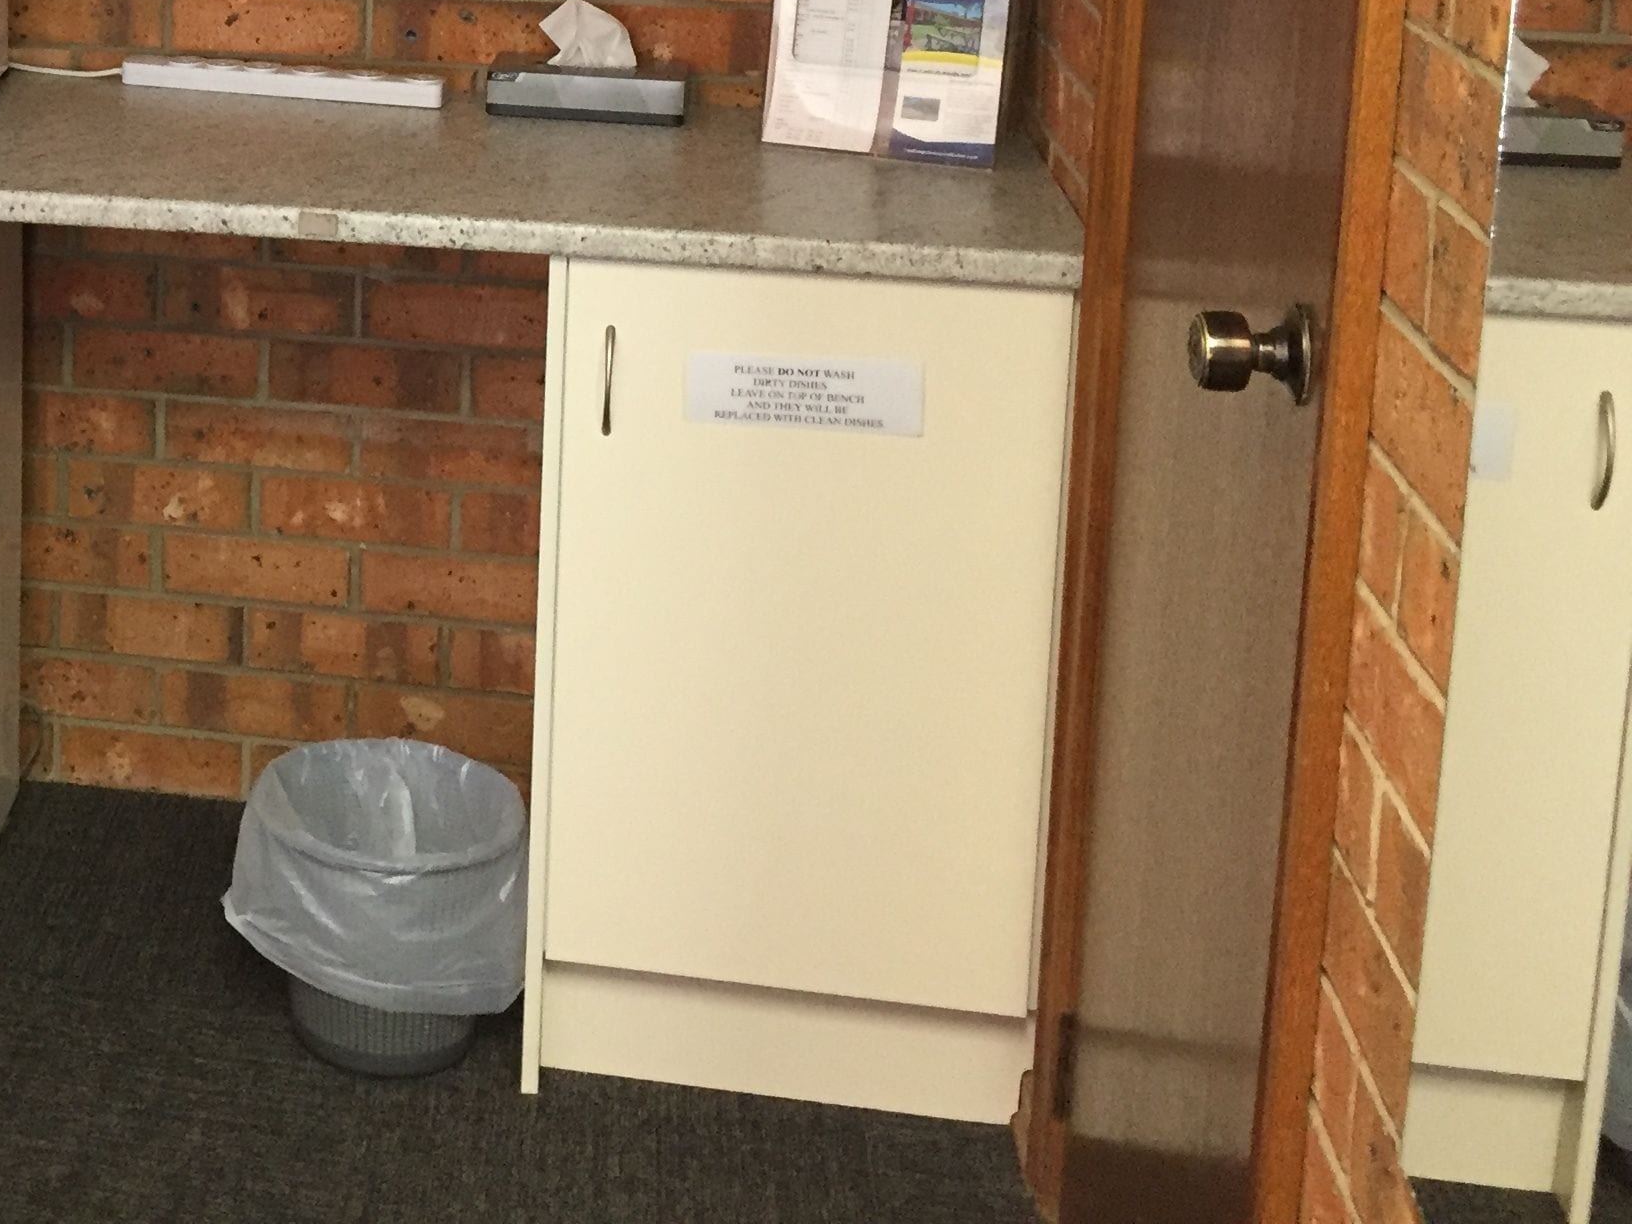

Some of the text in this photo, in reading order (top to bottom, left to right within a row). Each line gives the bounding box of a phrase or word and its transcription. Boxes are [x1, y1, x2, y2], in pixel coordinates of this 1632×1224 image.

[734, 365, 855, 380] PLEASE DO NOT WASH
[753, 378, 828, 390] DIRTY DISHES
[731, 388, 865, 404] LEAVE ON TOP OF BENCH
[746, 400, 849, 415] AND THEY WILL BE
[714, 410, 884, 427] REPLACED WITH CLEAN DISHES
